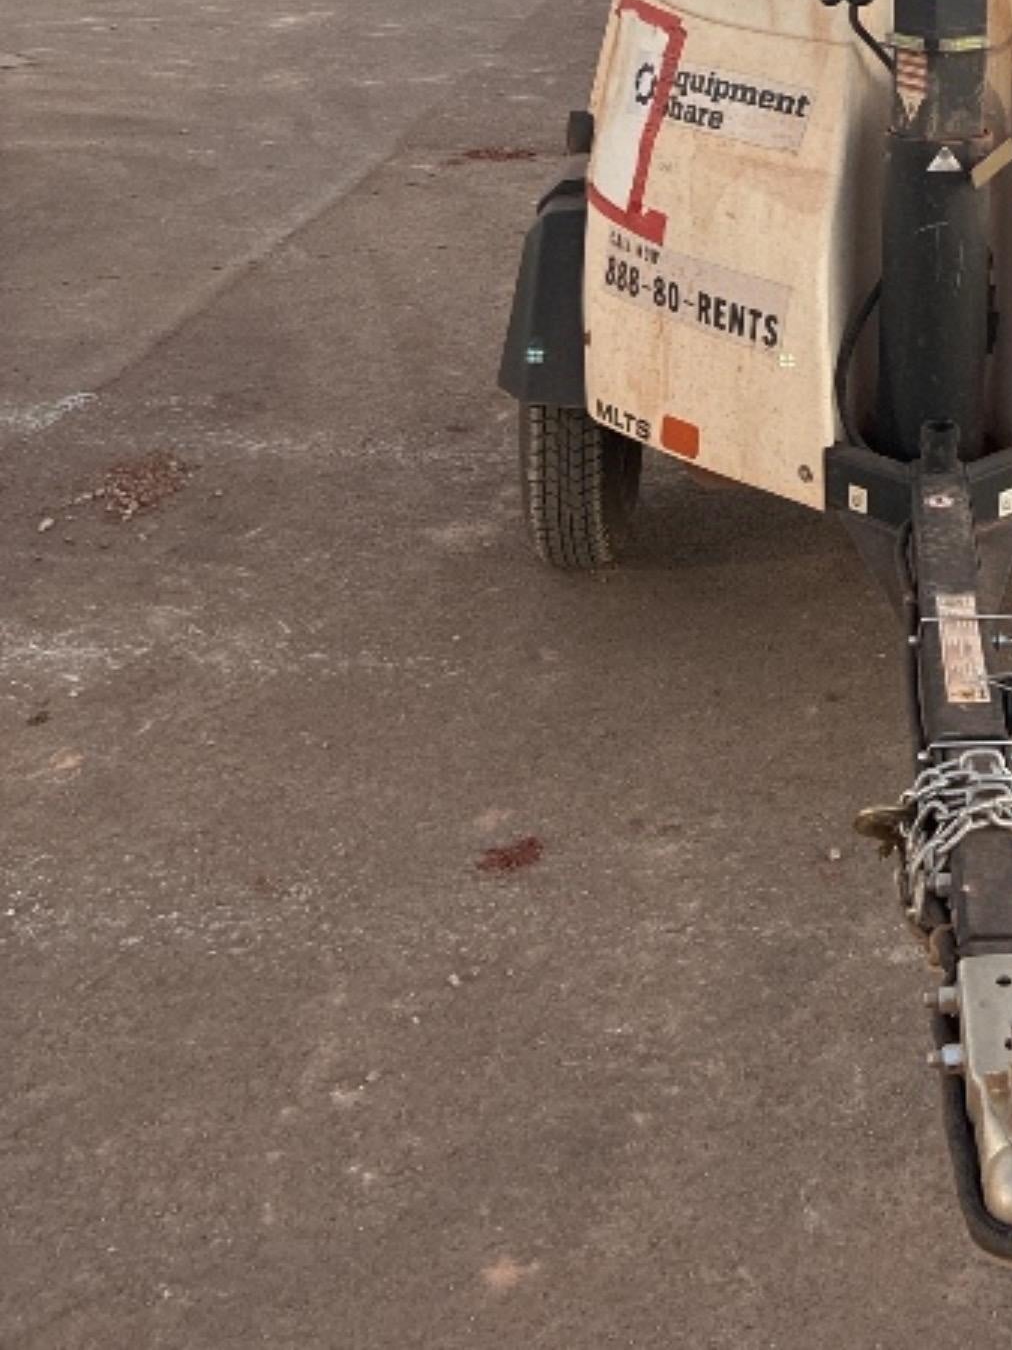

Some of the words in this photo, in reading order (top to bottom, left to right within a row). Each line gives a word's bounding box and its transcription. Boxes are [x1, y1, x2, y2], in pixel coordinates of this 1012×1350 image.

[664, 93, 724, 130] hare
[672, 70, 811, 118] quipment
[605, 256, 779, 348] 888-80-RENTS
[595, 398, 653, 440] MLTS
